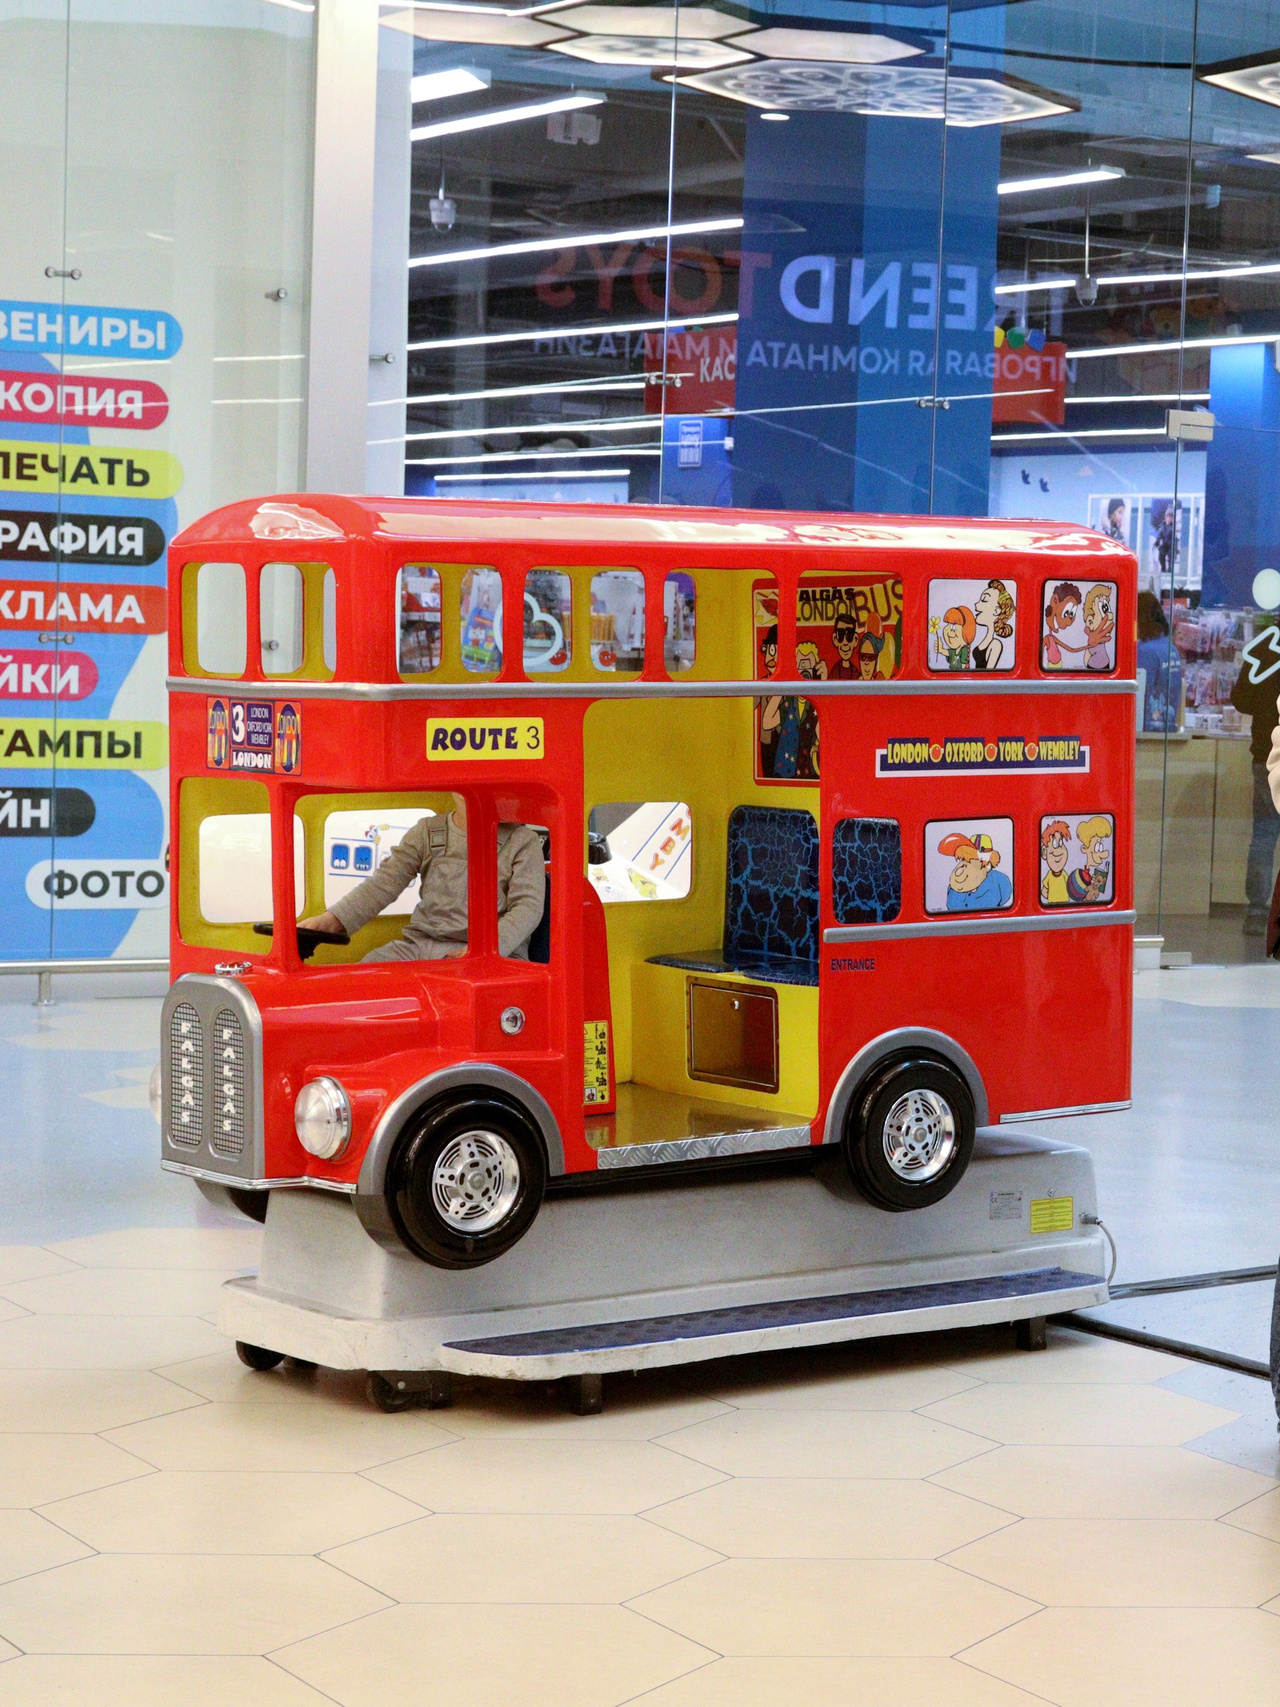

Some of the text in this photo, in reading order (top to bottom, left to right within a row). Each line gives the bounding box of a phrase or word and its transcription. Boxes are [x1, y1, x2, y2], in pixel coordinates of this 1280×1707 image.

[0, 381, 144, 419] КОПИЯ
[0, 520, 144, 556] РАФИЯ
[232, 704, 245, 743] 3
[0, 729, 142, 759] АМПЫ
[431, 726, 540, 751] ROUTE 3
[887, 740, 1081, 764] LONDON OXFORD YORK WEMBLEY
[232, 752, 272, 769] LONDON
[43, 870, 165, 899] ФОТО
[830, 958, 876, 972] ENTRANCE
